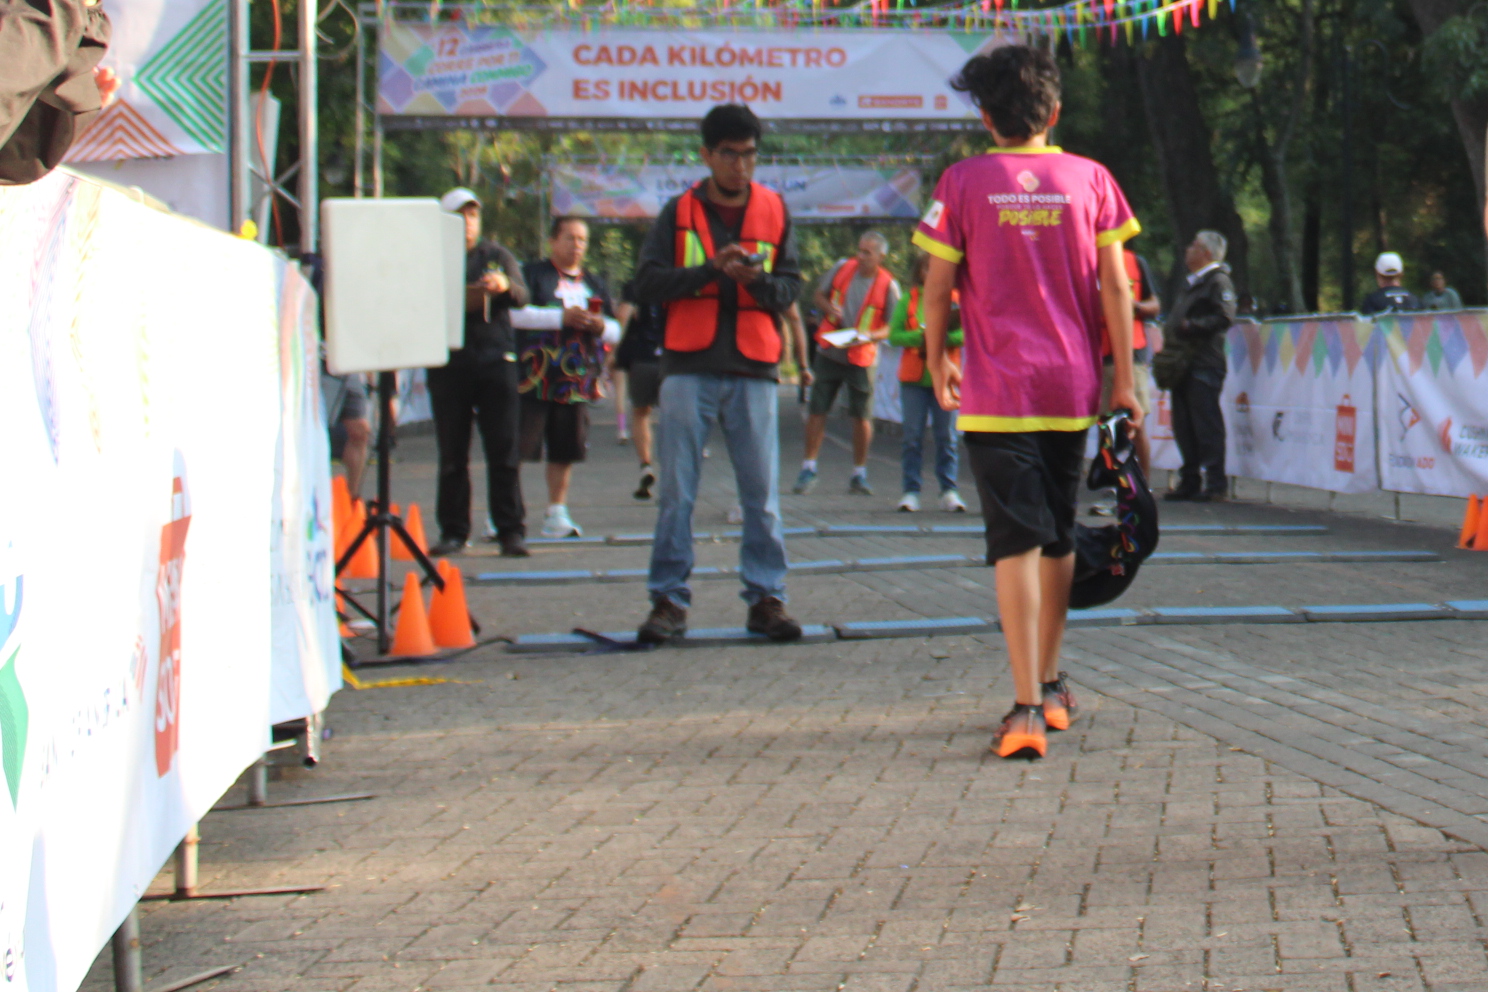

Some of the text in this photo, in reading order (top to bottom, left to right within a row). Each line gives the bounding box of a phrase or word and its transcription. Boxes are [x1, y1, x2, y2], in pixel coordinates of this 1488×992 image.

[572, 41, 847, 68] CADA KILÓMETRO
[572, 74, 782, 102] ES INCLUSIÓN
[987, 193, 1072, 205] TODO ES POSIBLE
